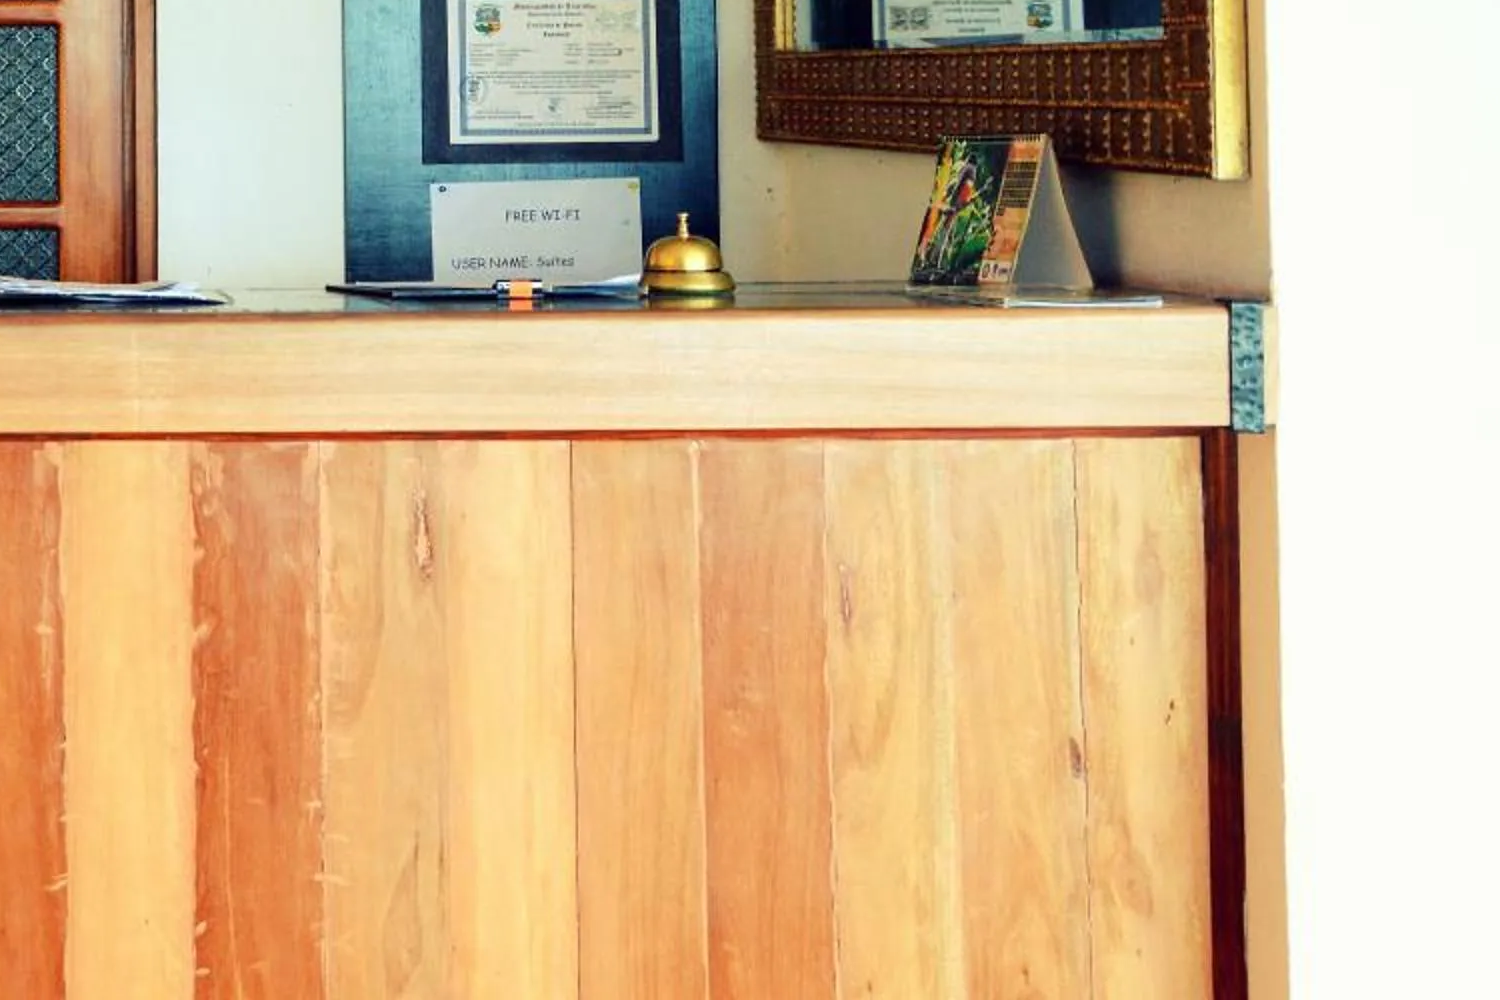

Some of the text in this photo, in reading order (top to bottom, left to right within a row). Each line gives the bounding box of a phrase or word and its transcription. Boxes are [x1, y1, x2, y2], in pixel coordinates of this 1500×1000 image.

[506, 210, 537, 222] FREE
[451, 258, 485, 269] USER
[536, 256, 575, 267] Suites
